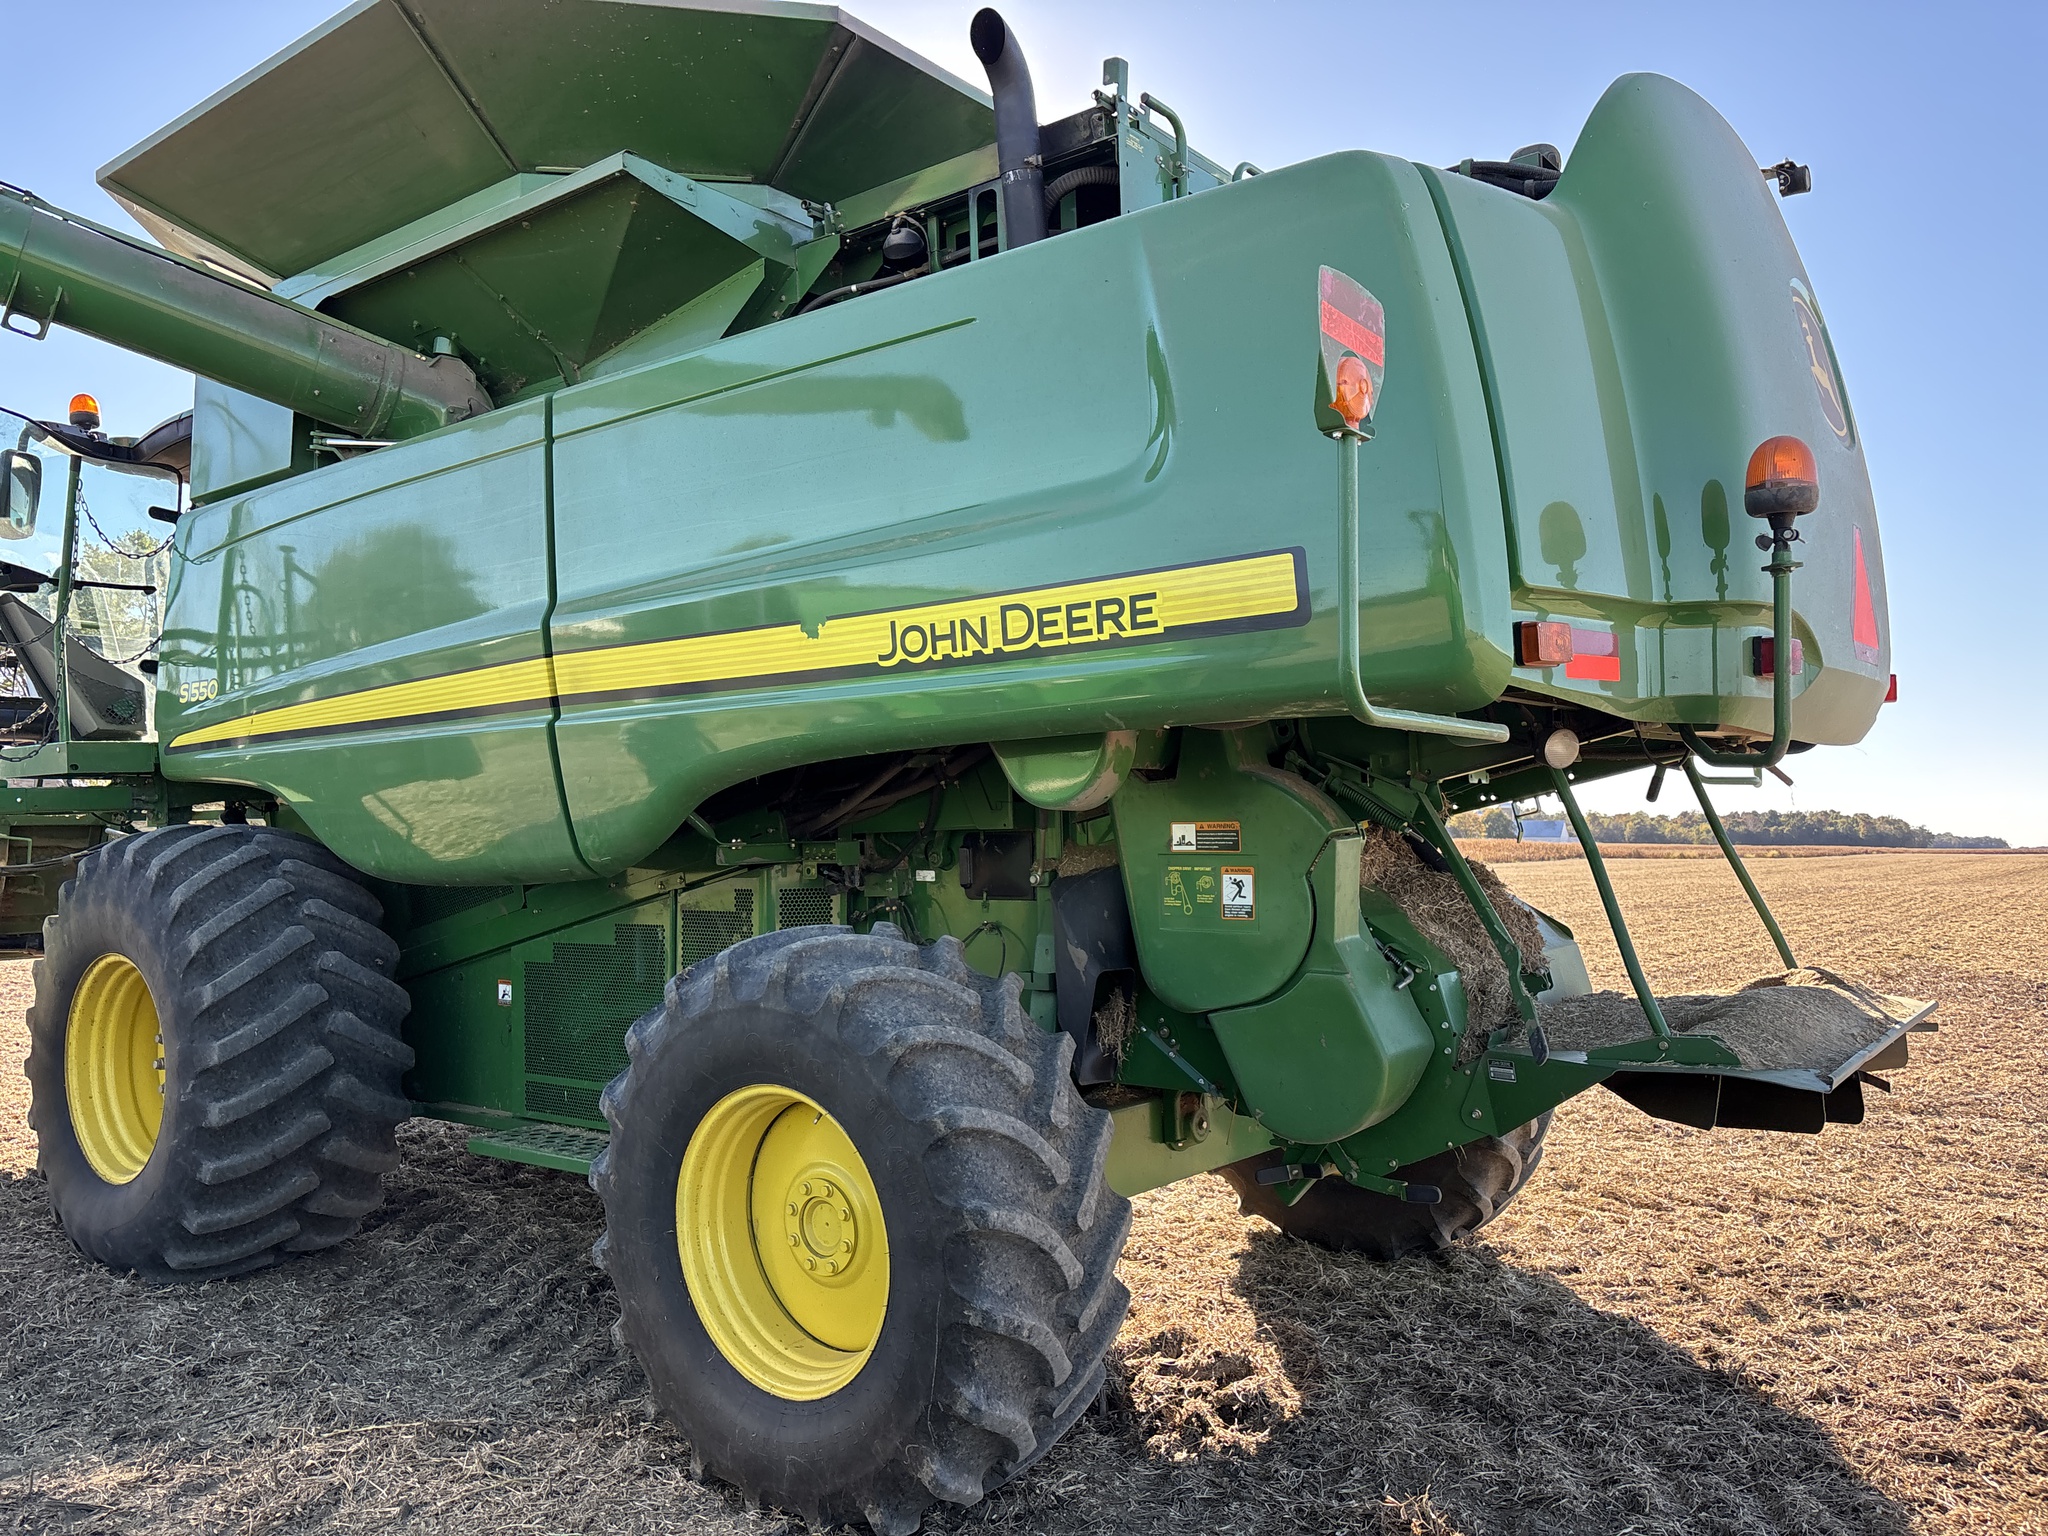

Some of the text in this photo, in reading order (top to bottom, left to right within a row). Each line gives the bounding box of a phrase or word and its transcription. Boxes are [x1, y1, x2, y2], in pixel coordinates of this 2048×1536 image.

[878, 592, 1158, 662] JOHN DEERE
[179, 679, 219, 704] S550
